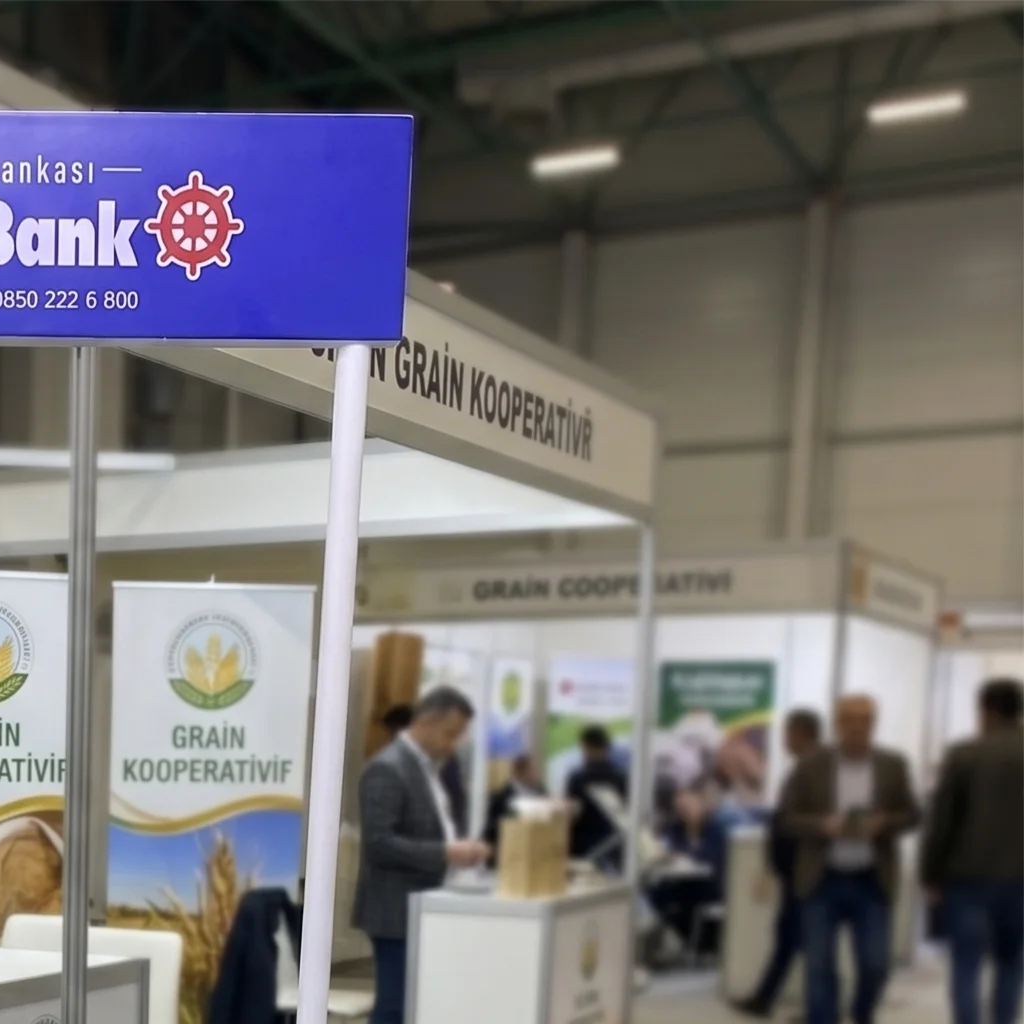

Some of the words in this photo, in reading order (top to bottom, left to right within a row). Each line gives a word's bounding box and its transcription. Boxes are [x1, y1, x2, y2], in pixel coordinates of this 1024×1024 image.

[44, 290, 79, 309] 222
[85, 290, 97, 309] 6
[103, 290, 139, 309] 800
[171, 720, 245, 749] GRAİN
